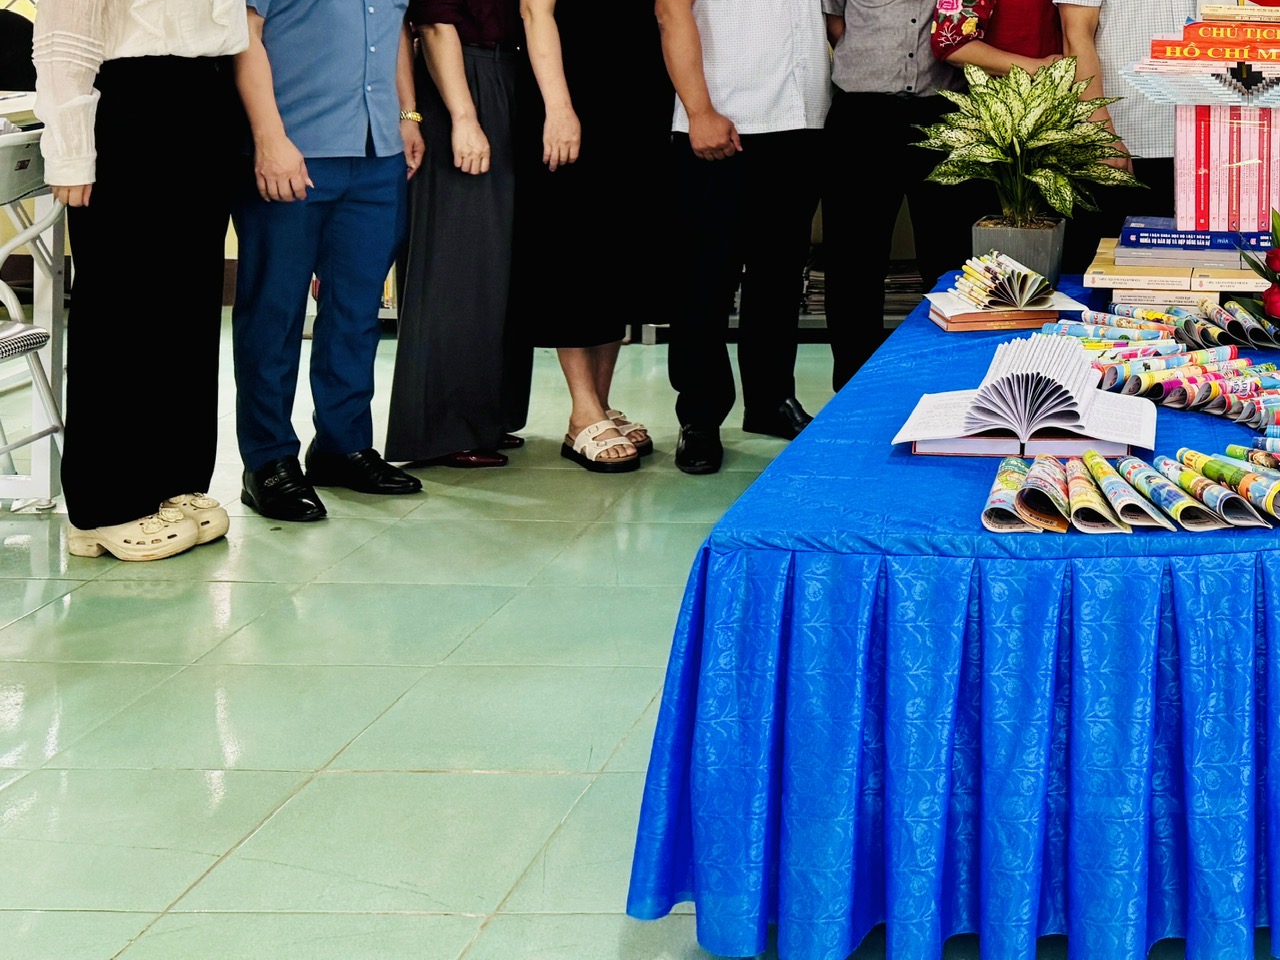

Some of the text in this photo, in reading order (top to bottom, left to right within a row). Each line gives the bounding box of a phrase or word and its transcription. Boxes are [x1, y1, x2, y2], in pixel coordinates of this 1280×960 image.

[1198, 24, 1239, 39] CHỦ
[1165, 41, 1201, 58] HỒ
[1207, 45, 1251, 59] CHÍ
